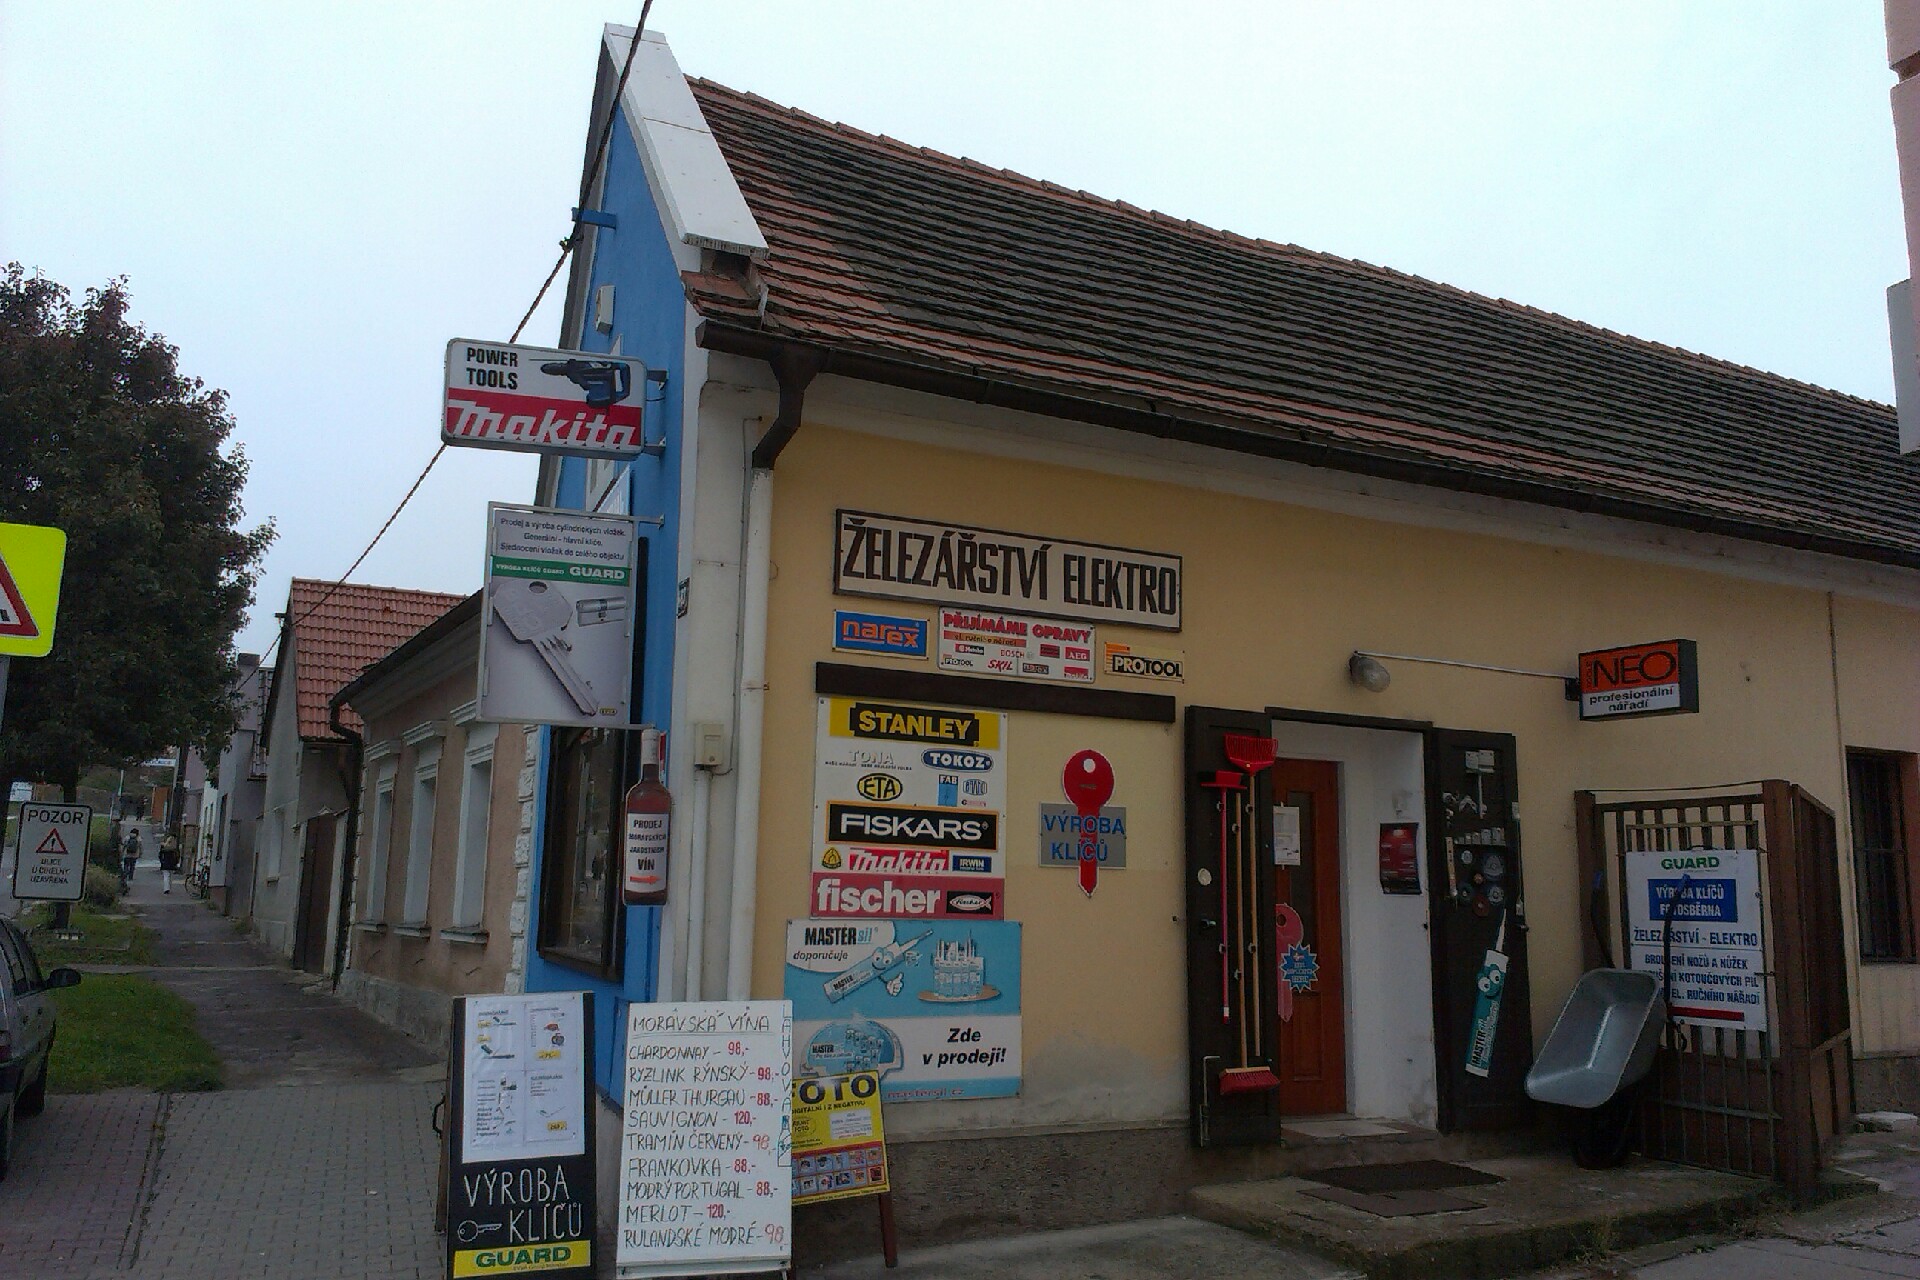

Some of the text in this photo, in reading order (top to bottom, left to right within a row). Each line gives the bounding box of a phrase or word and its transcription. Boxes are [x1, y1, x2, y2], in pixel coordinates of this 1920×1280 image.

[466, 347, 519, 367] POWER
[466, 367, 519, 390] TOOLS
[501, 518, 523, 528] Prodej
[532, 521, 554, 531] výroba
[524, 532, 558, 542] Generální
[563, 535, 583, 545] hlavní
[500, 542, 624, 561] Sjednocení vložek do celého objektu
[569, 566, 625, 579] GUARD
[842, 517, 1177, 616] ŽELEZÁŘSTVÍ ELEKTRO
[842, 620, 919, 648] narex
[943, 611, 1091, 643] PŘIJÍMÁME OPRAVY
[1000, 649, 1025, 659] BOSCH
[1068, 651, 1087, 660] AEG
[987, 659, 1013, 672] SKIL
[1113, 655, 1182, 678] PROTOOL
[1593, 650, 1677, 688] NEO
[1589, 686, 1674, 706] profesionální
[1608, 699, 1649, 712] nářadí
[859, 710, 972, 740] STANLEY
[849, 750, 894, 765] TONA
[929, 752, 986, 770] TOKOZ
[863, 776, 896, 799] ETA
[940, 775, 957, 785] FAB
[27, 809, 84, 825] POZOR
[633, 819, 663, 829] PRODEJ
[840, 812, 983, 841] FISKARS
[1043, 811, 1125, 835] VÝROBA
[1051, 838, 1108, 862] KLÍČŮ
[637, 857, 655, 871] VÍN
[960, 858, 984, 868] IRWIN
[1661, 856, 1720, 870] GUARD
[817, 878, 941, 914] fischer
[1656, 883, 1725, 900] VÝRBA KLÍČŮ
[1659, 901, 1722, 917] FOOSBĚRNA
[1634, 926, 1700, 944] ŽELEZŘSTVÍ
[1709, 932, 1758, 946] ELEKTRO
[793, 950, 849, 962] doporučuje
[1687, 954, 1710, 968] NOŽŮ
[1678, 971, 1742, 987] KOTOUČOVÝCH
[1745, 978, 1759, 988] PIL
[1671, 989, 1685, 1000] EL.
[1687, 987, 1725, 1002] RUČNÍHO
[1727, 990, 1760, 1005] NÁŘADÍ
[633, 1012, 770, 1033] MORAVSKÁ VÍNA
[947, 1027, 982, 1044] Zde
[629, 1045, 710, 1060] CHARDONNAY
[922, 1047, 1007, 1068] v prodeji!
[629, 1067, 686, 1083] RYZLINK
[694, 1061, 749, 1083] RÝNSKÝ
[628, 1110, 718, 1128] SAUVIGNON
[626, 1130, 685, 1151] TRAMÍN
[688, 1129, 744, 1150] ČERVENÝ
[628, 1158, 721, 1177] FRANKOVKA
[464, 1164, 570, 1207] VÝROBA
[627, 1178, 672, 1201] MODRÝ
[674, 1181, 745, 1200] PORTUGAL
[509, 1202, 582, 1243] KLÍČŮ
[626, 1204, 693, 1224] MERLOT
[624, 1222, 704, 1248] RULANDSKÉ
[708, 1220, 757, 1245] MODRÉ
[475, 1246, 571, 1268] GUARD
